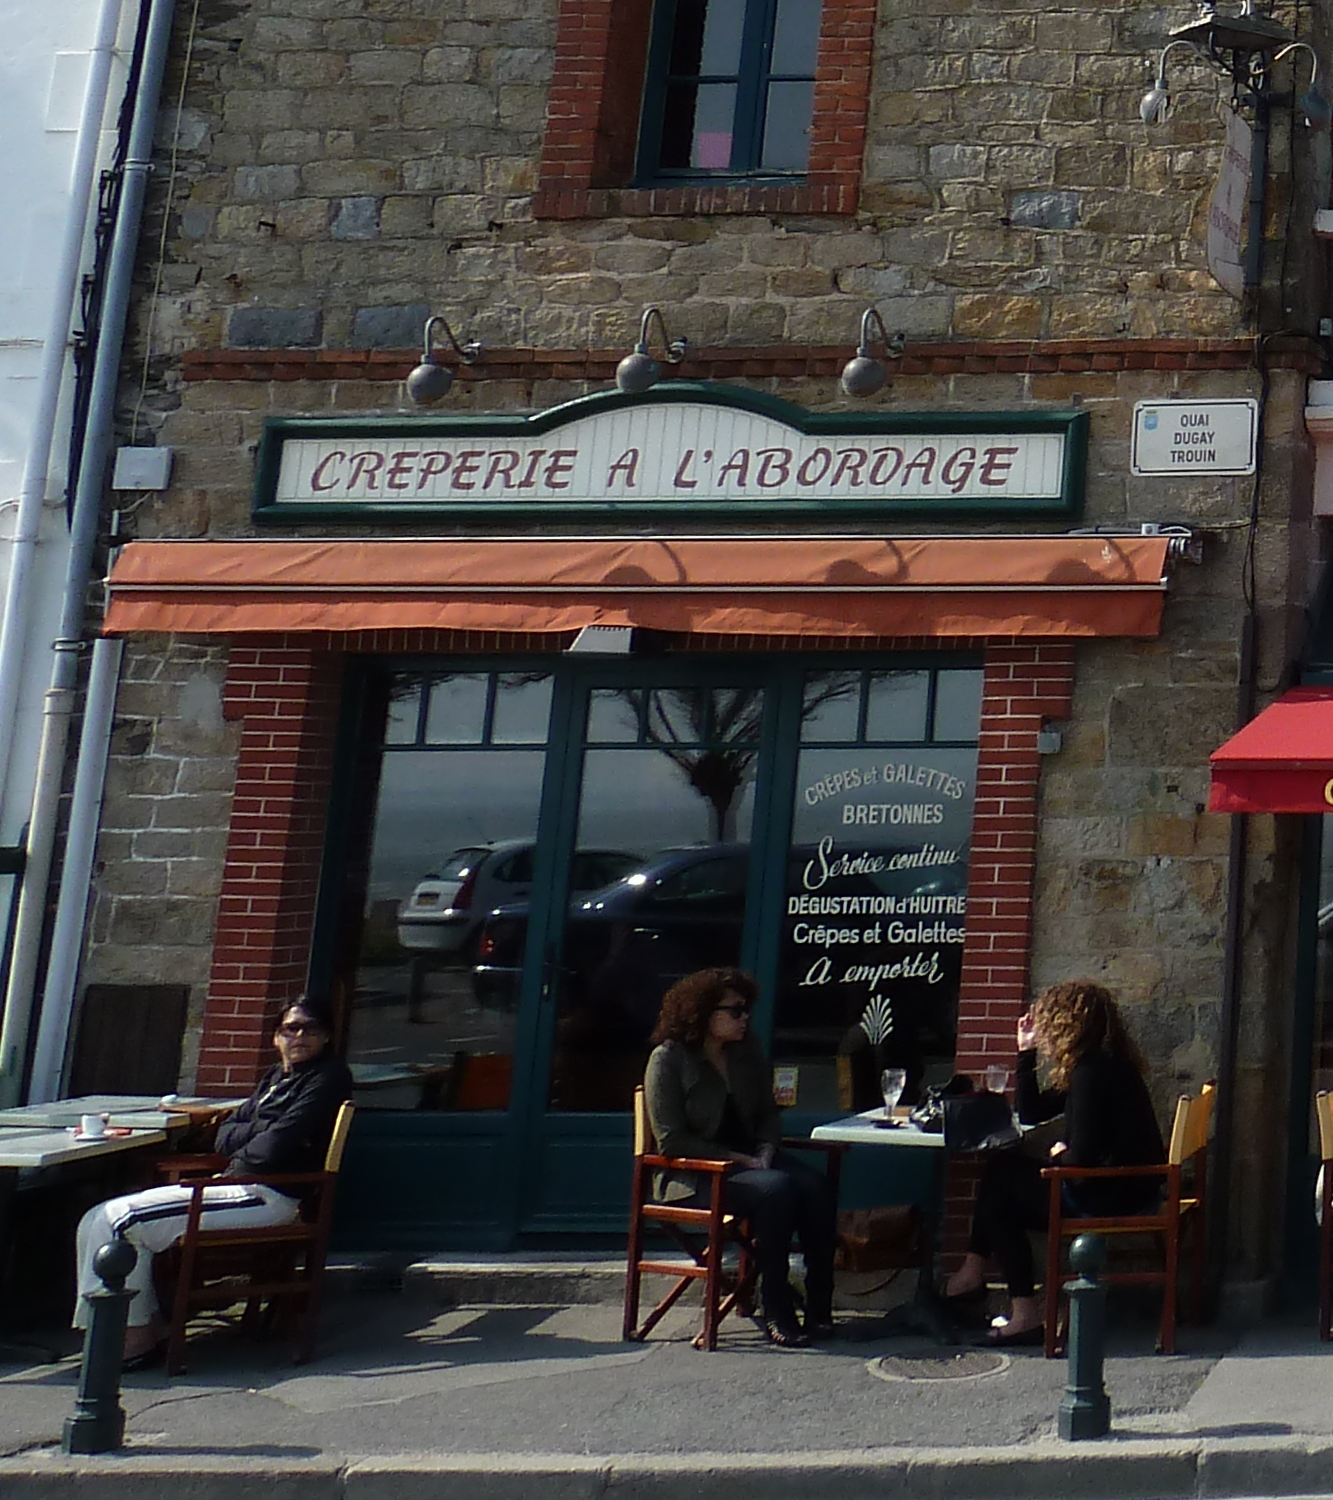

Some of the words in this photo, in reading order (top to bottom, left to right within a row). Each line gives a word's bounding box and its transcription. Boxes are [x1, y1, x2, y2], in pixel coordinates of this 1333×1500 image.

[1180, 414, 1209, 427] QUAI
[1173, 431, 1215, 445] DUGAY
[1170, 449, 1216, 463] TROUIN
[311, 449, 579, 492] CREPERIE
[606, 448, 641, 489] A
[673, 445, 1019, 493] L'ABORDAGE
[805, 767, 862, 806] CRÊPES
[863, 766, 880, 786] et
[883, 763, 966, 800] GALETTES
[842, 804, 944, 825] BRETONNES
[803, 835, 885, 890] Service
[886, 843, 961, 872] continu
[788, 894, 896, 915] DÉGUSTATION
[863, 921, 882, 944] et
[887, 921, 966, 944] Galettes
[839, 951, 945, 991] emporter
